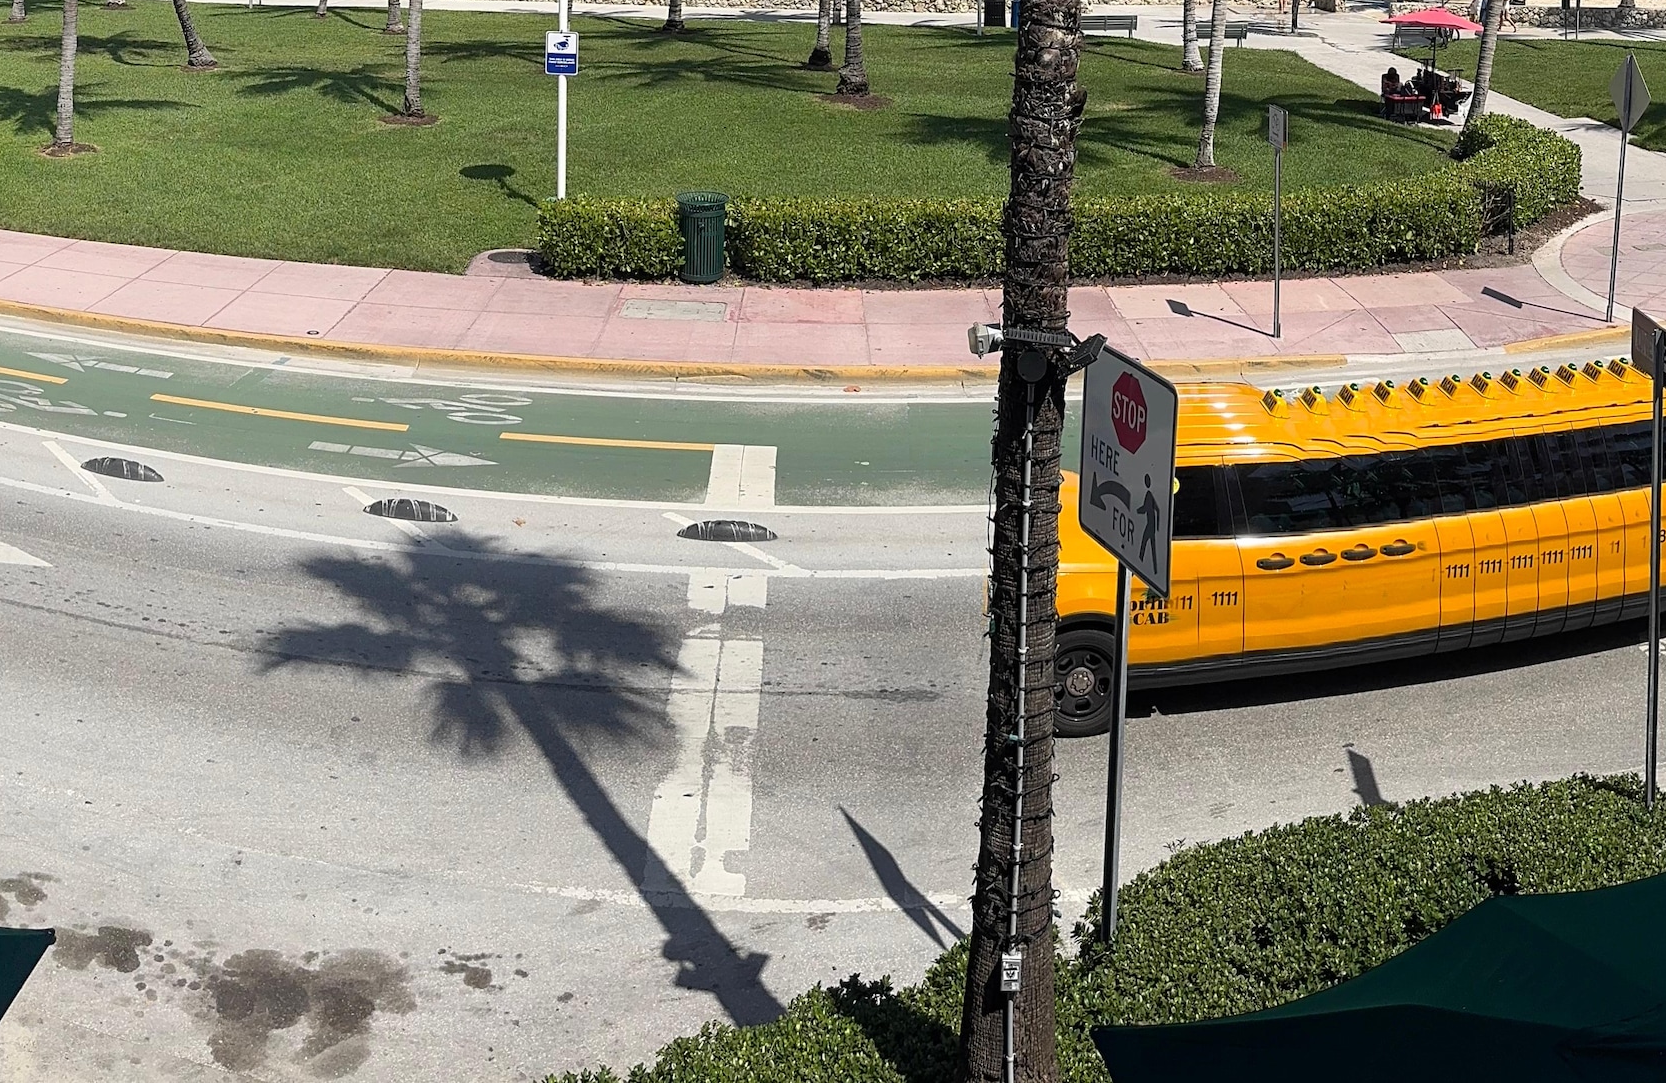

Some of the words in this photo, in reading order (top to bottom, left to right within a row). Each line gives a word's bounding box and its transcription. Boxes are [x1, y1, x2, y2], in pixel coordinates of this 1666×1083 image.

[1113, 390, 1146, 433] STOP
[1091, 434, 1120, 477] HERE
[1112, 506, 1135, 546] FOR
[1132, 612, 1170, 626] CAB
